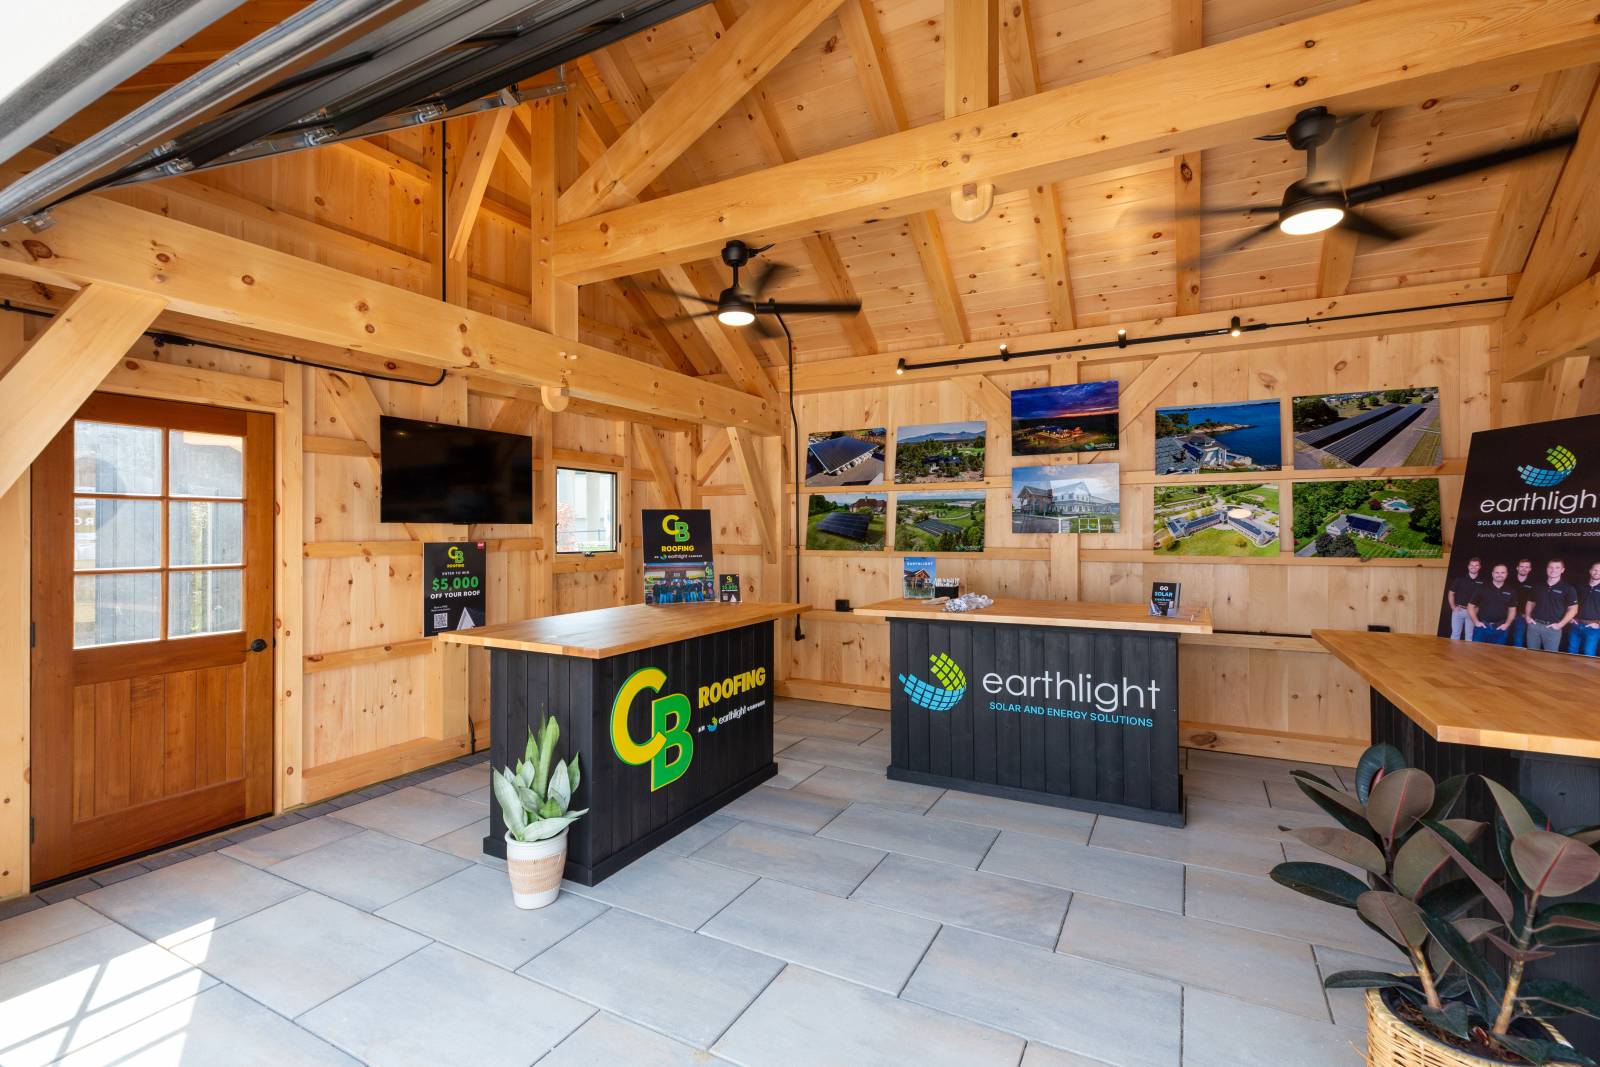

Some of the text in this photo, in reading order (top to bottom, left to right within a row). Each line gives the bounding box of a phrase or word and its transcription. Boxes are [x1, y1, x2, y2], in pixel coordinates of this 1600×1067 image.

[1480, 489, 1600, 514] earthligh
[432, 576, 479, 591] $5,000
[699, 667, 766, 709] ROOFING
[983, 671, 1160, 713] earthlight
[719, 705, 746, 724] earthlight
[989, 702, 1153, 727] SOLAR AND ENERGY SOLUTIONS
[610, 667, 694, 792] CB
